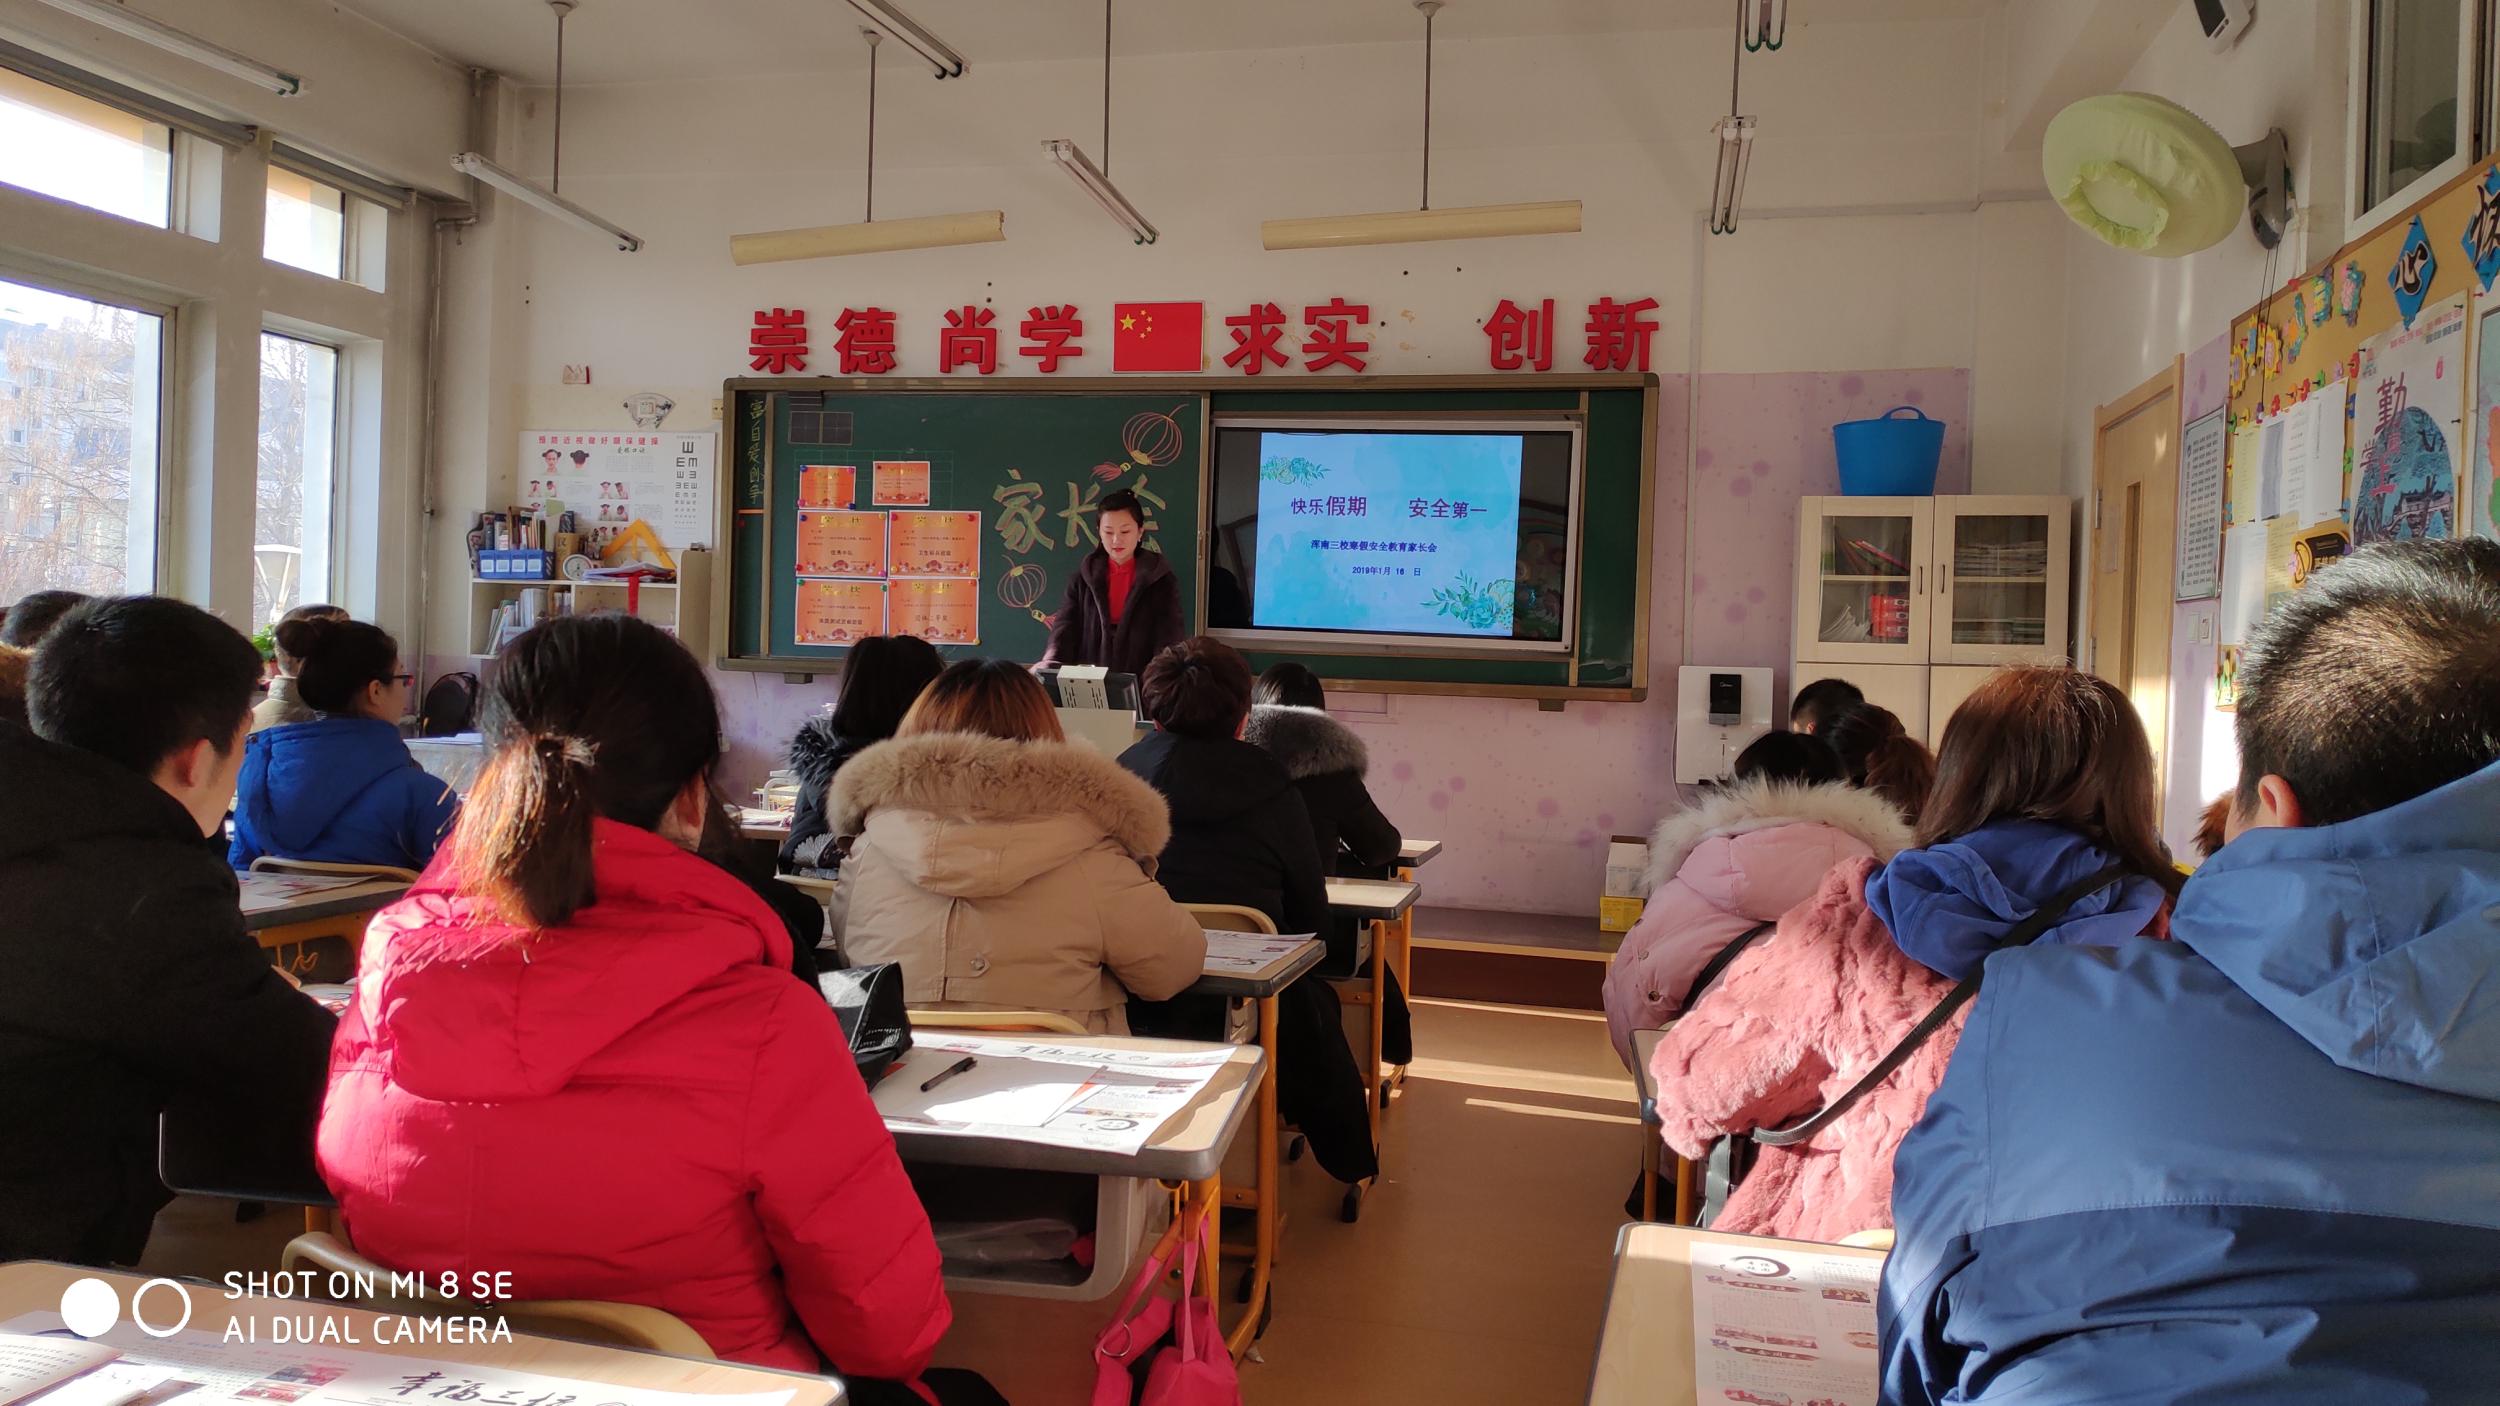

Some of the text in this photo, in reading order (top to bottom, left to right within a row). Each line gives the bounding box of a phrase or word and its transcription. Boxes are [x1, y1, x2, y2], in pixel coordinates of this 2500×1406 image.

[748, 297, 1660, 375] 崇德 尚学 求实 创新
[1290, 495, 1488, 519] 快乐假期 安全第一
[1310, 539, 1438, 553] 浑南三校寒假安全教育家长会
